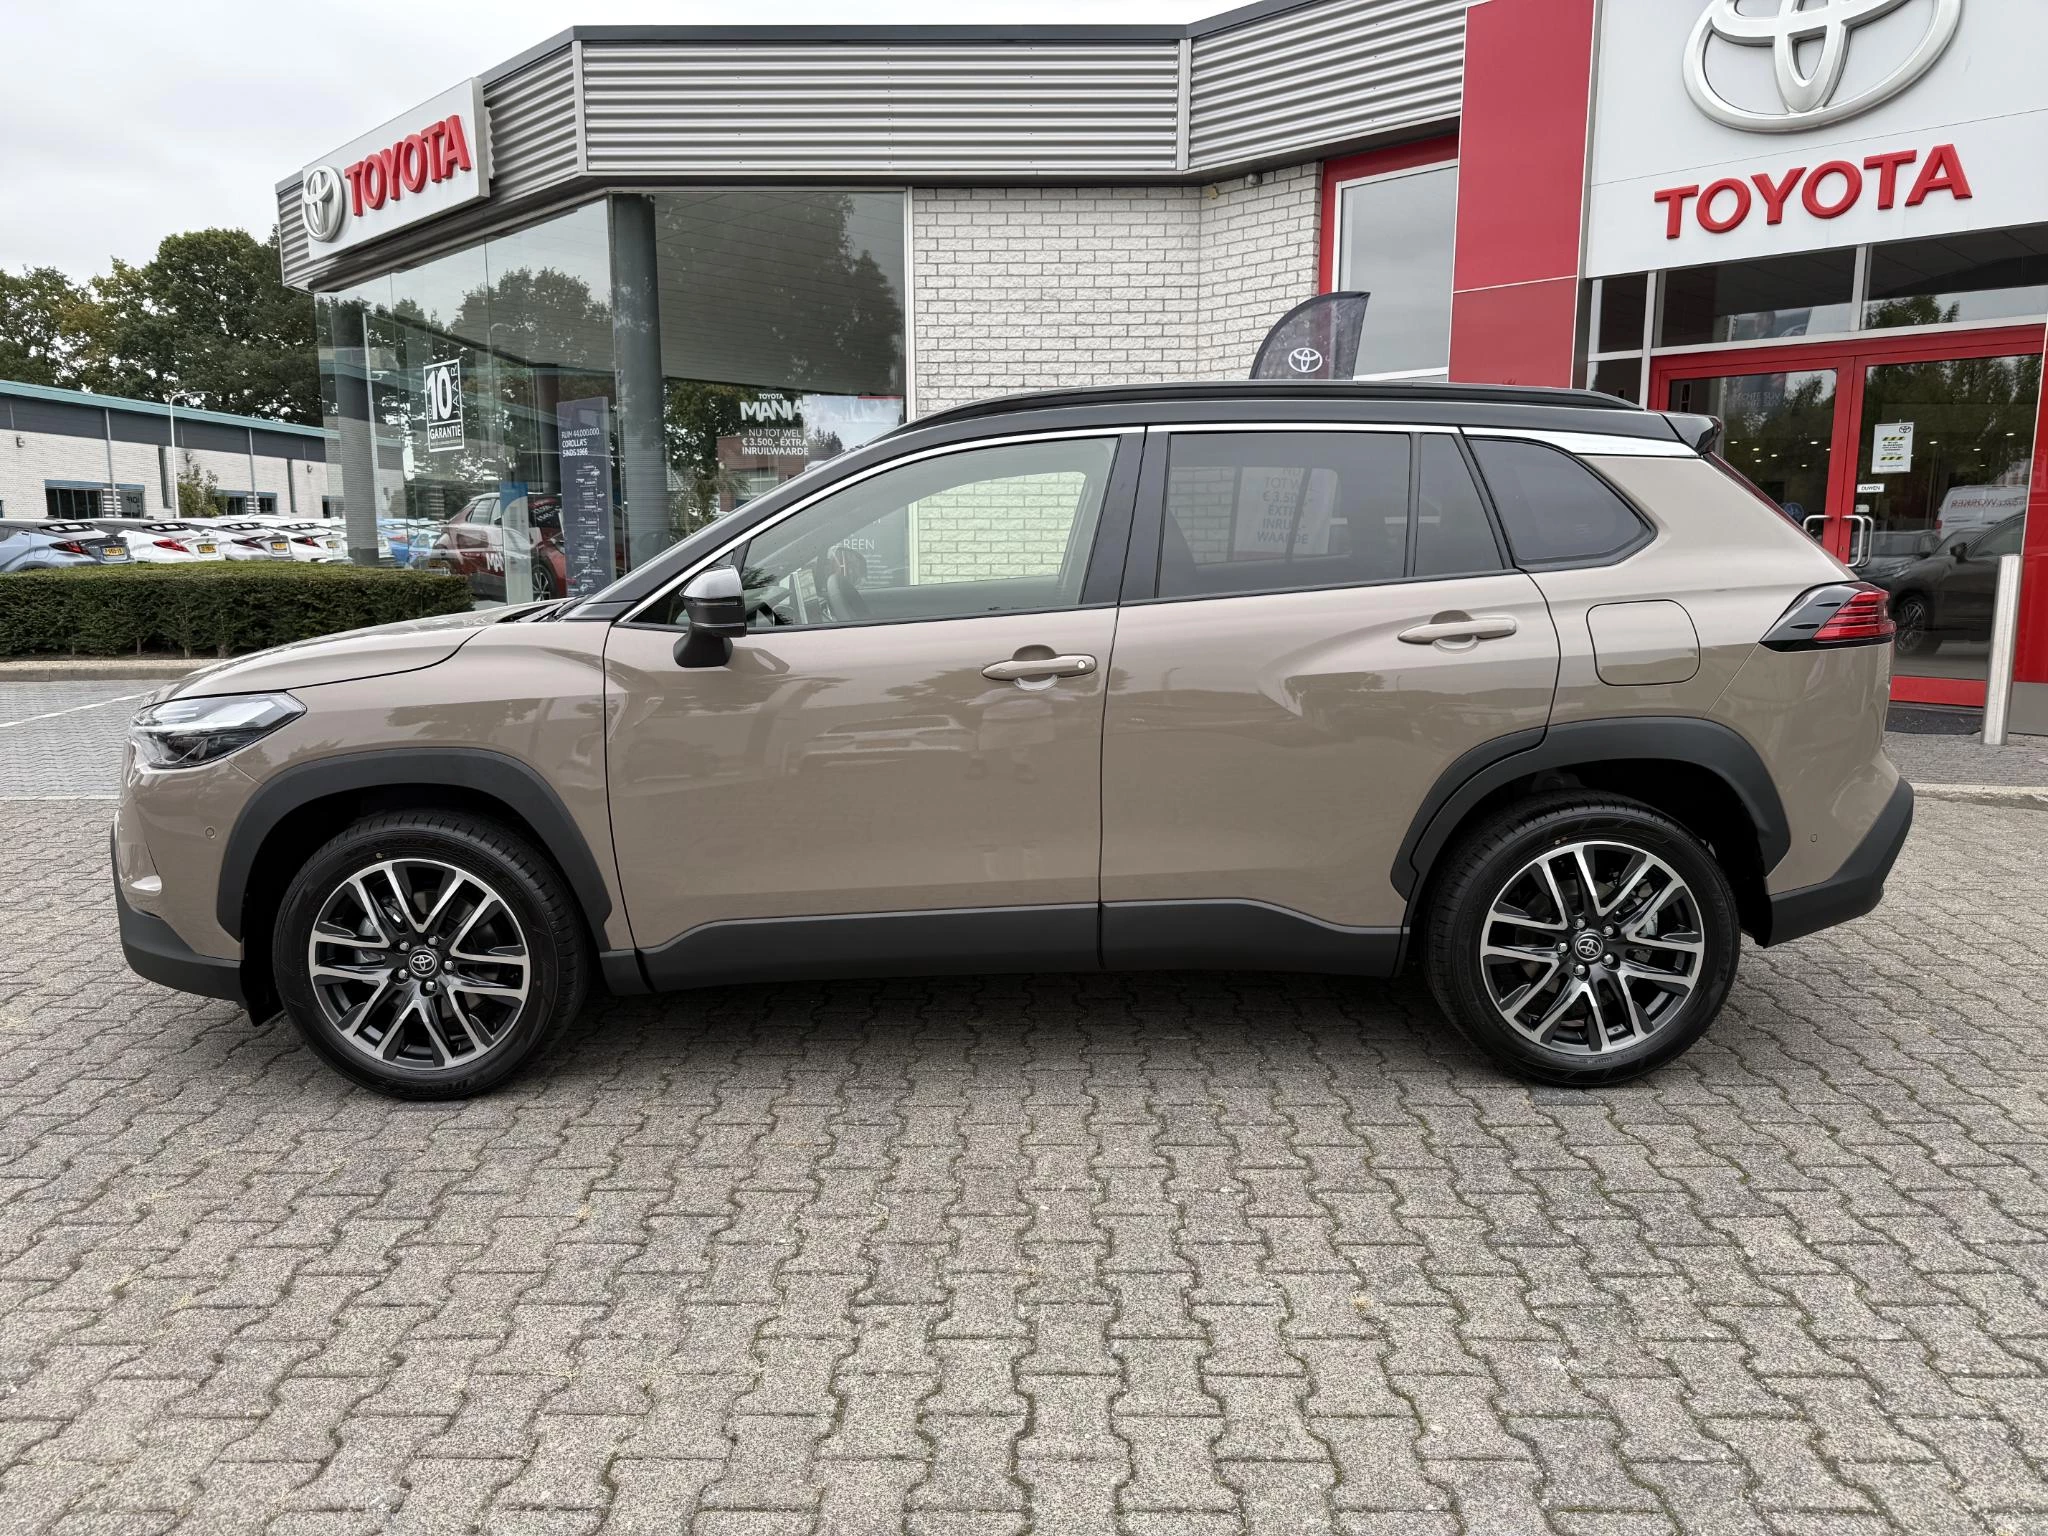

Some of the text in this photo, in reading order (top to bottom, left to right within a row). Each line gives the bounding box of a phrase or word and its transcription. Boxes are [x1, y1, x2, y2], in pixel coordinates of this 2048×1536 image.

[344, 115, 471, 217] TOYOTA
[1654, 143, 1973, 240] TOYOTA
[426, 366, 453, 420] 10
[450, 364, 461, 416] JAAR
[740, 399, 804, 422] MANIA
[429, 425, 462, 440] GARANTIE
[748, 428, 801, 438] NU TOT WEL
[780, 438, 809, 447] EXTRA
[742, 446, 809, 456] INRUILWAARDE
